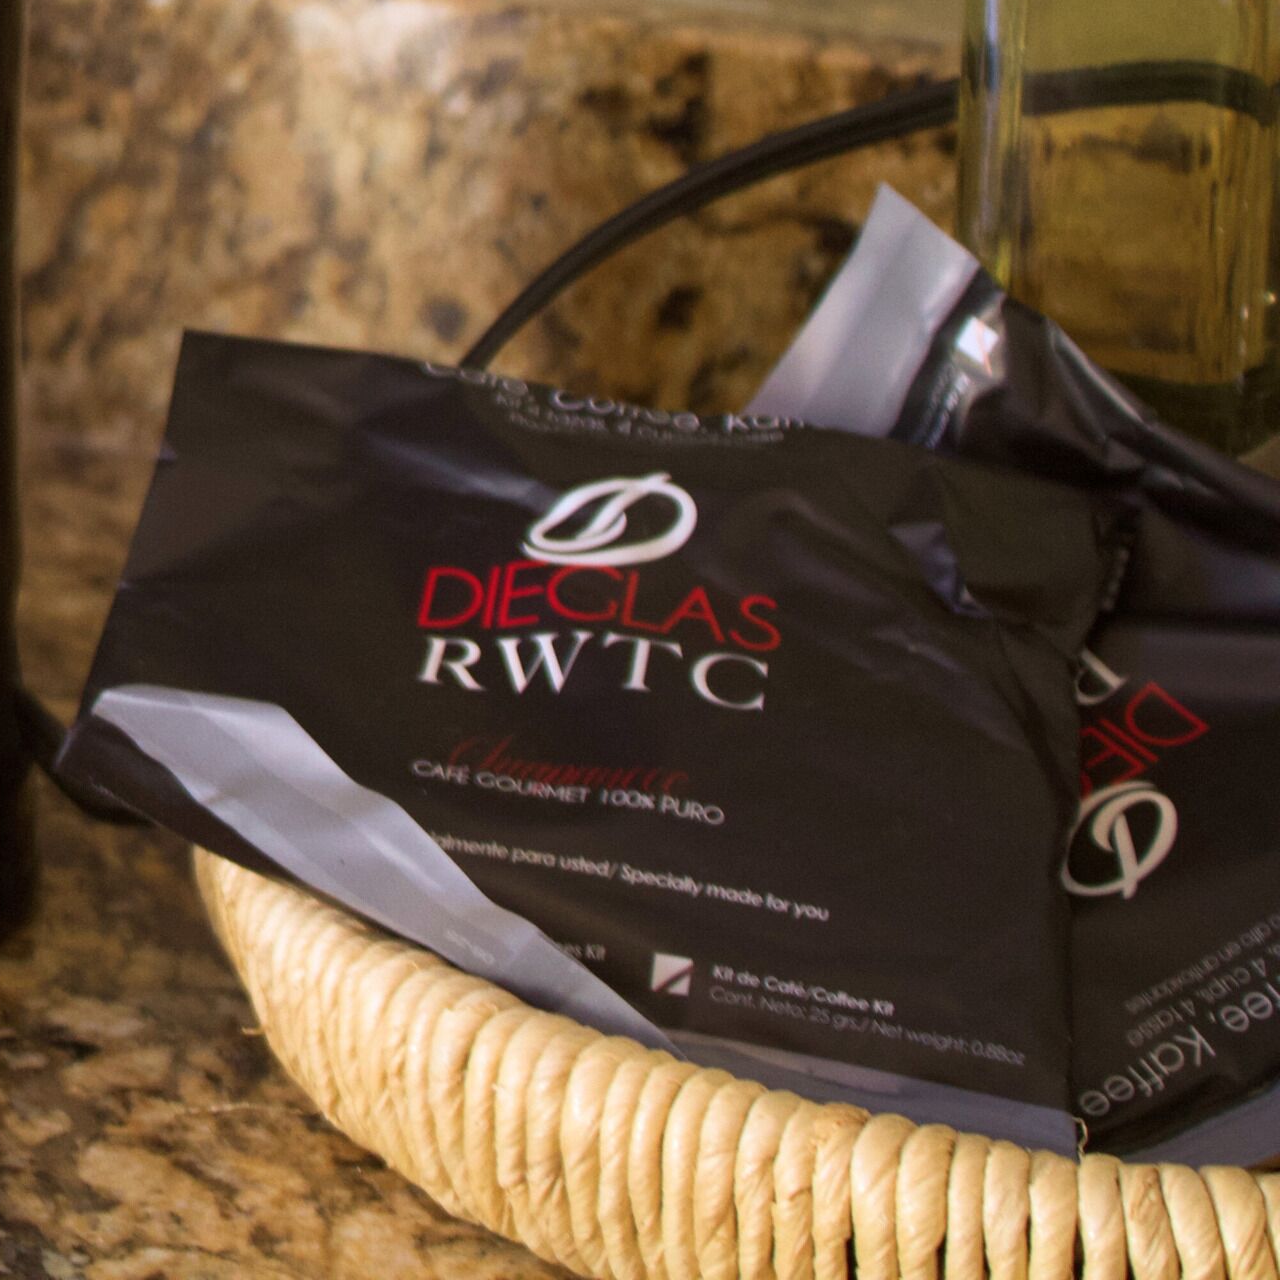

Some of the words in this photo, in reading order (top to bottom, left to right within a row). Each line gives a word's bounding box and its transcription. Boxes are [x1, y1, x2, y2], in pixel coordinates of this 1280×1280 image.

[417, 560, 782, 652] DIECLAS
[416, 629, 770, 712] RWTC
[475, 772, 591, 804] GOURMET
[600, 788, 655, 810] 100%
[660, 796, 726, 825] PURO
[511, 847, 556, 865] para
[621, 863, 702, 898] Specially
[706, 883, 763, 908] made
[766, 893, 790, 912] for
[793, 902, 830, 922] you
[1079, 1024, 1216, 1117] Kaffee
